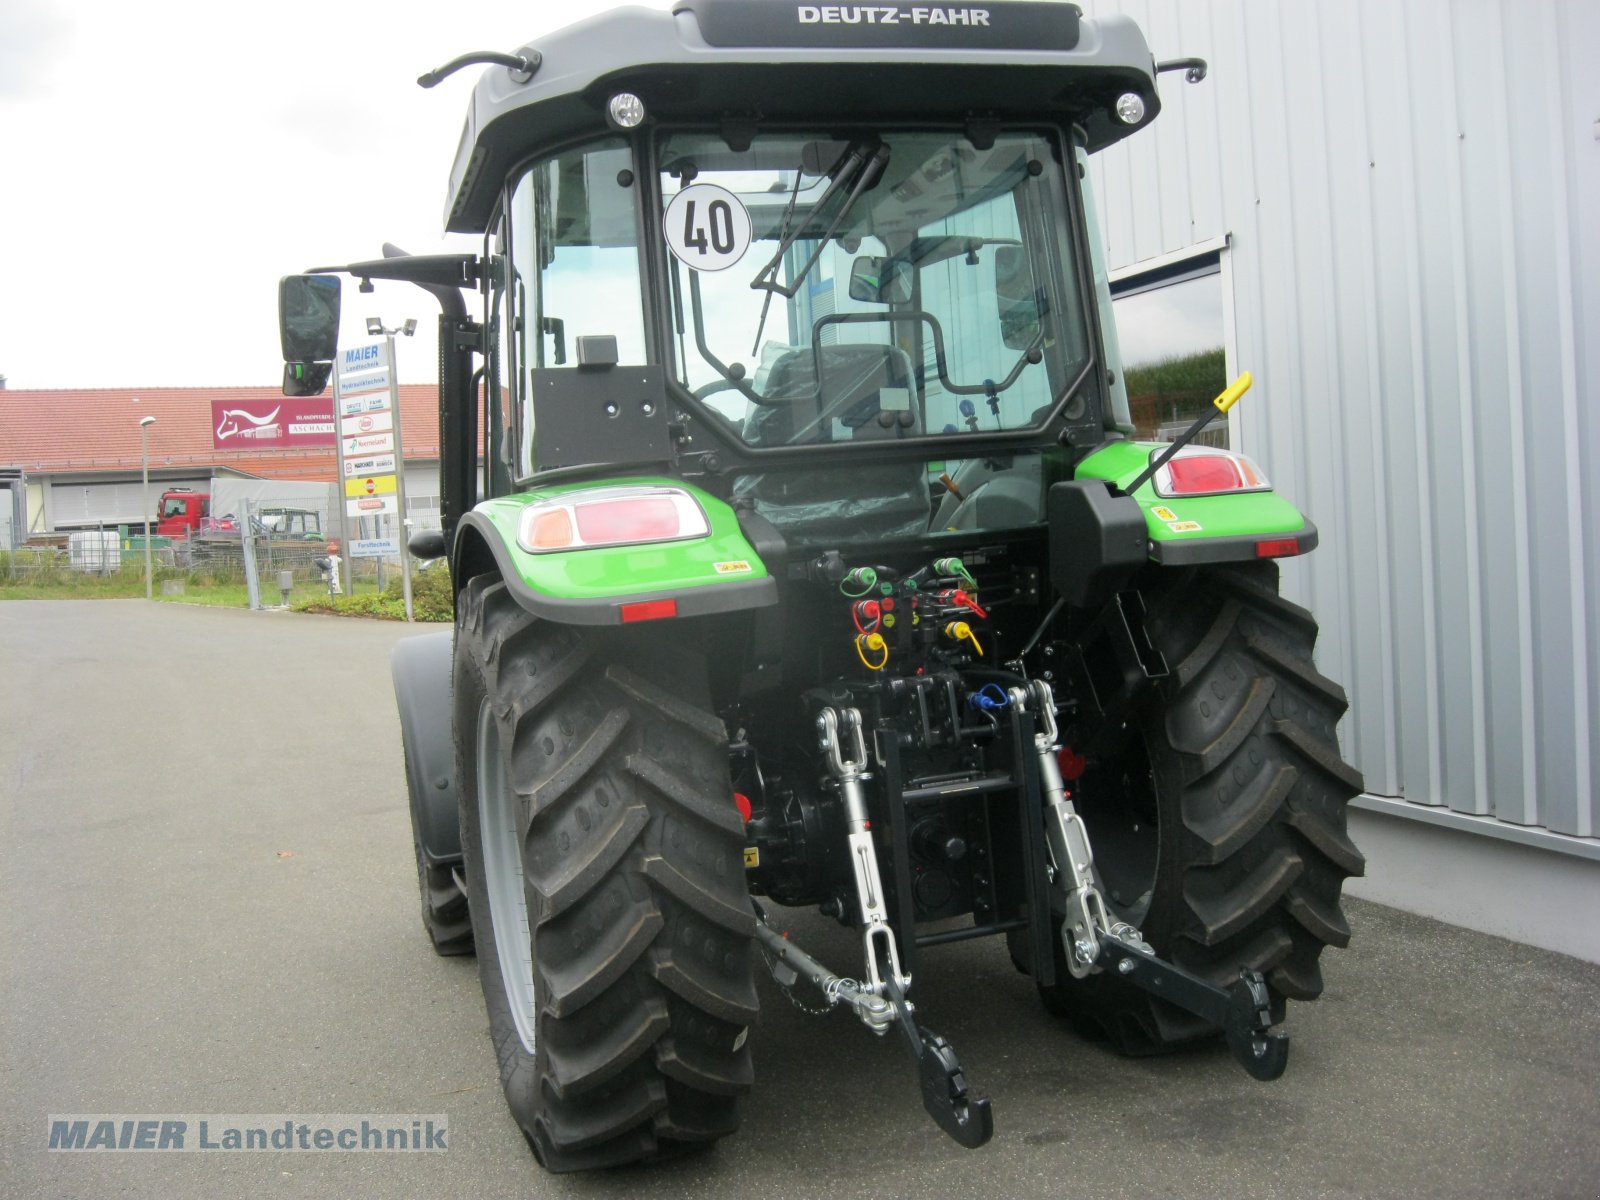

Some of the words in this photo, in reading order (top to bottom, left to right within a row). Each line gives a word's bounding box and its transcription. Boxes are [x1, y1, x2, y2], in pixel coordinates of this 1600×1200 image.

[797, 6, 991, 26] DEUTZ-FAHR
[683, 199, 735, 255] 40
[346, 345, 378, 363] MAIER
[346, 361, 379, 372] Landtechnik
[341, 377, 385, 391] Hydrauliktechnik
[357, 541, 391, 549] Forsttechnik
